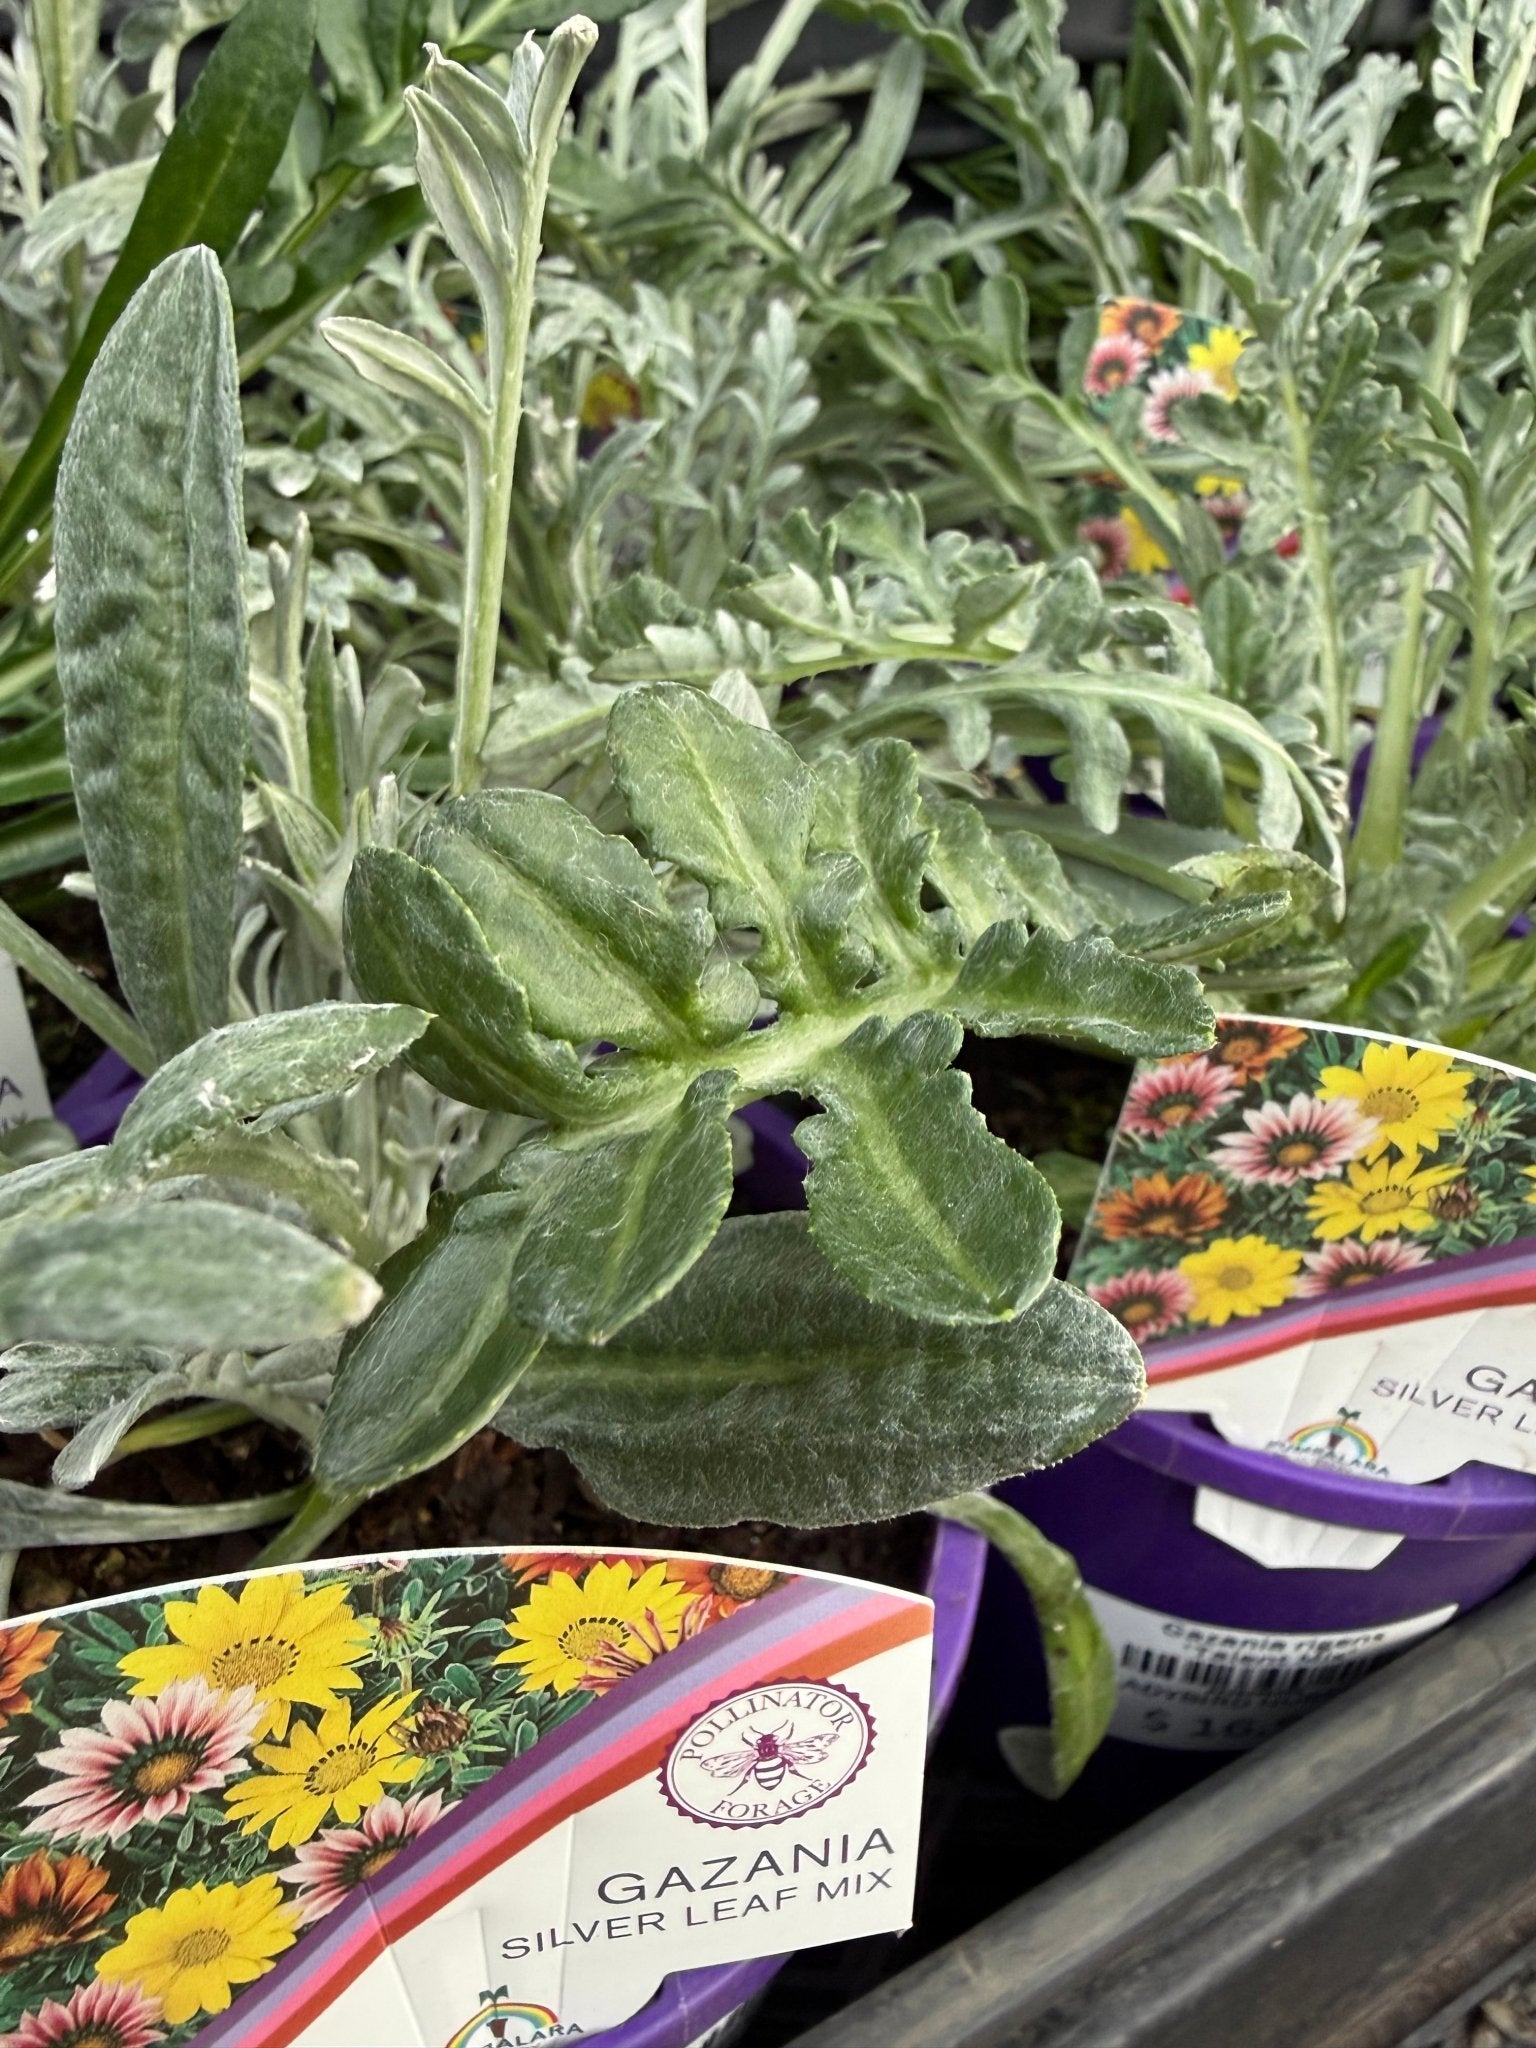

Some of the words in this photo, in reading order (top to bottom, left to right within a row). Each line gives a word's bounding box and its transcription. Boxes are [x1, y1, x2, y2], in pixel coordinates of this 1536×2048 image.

[1371, 1376, 1504, 1426] SILVER
[680, 1690, 855, 1762] POLLINATOR
[709, 1778, 832, 1818] FORAGE
[597, 1827, 894, 1905] GAZANIA
[501, 1912, 666, 1960] SILVER
[686, 1886, 797, 1927] LEAF
[817, 1867, 893, 1903] MIX
